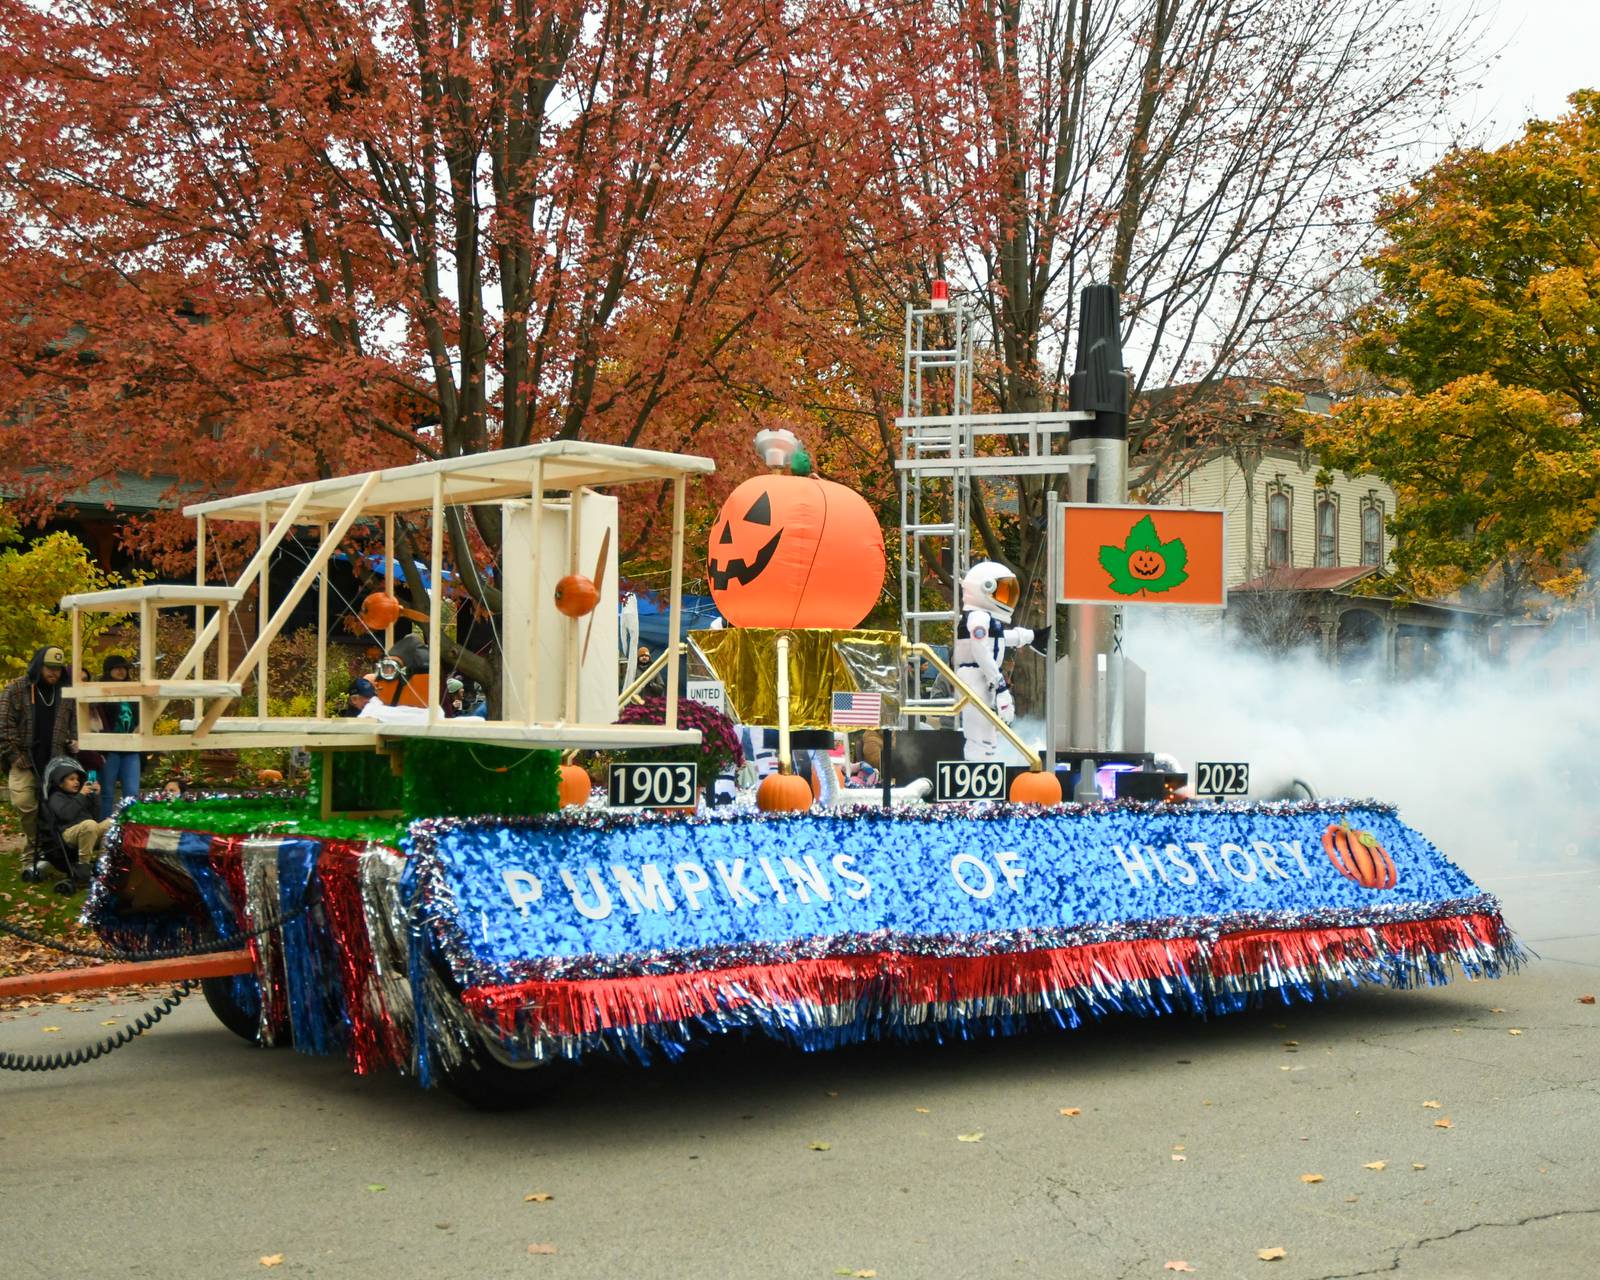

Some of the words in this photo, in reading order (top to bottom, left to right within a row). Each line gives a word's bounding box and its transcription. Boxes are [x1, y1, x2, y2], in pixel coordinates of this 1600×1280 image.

[690, 688, 720, 699] UNITED
[614, 766, 692, 804] 1903
[940, 764, 1003, 797] 1969
[1198, 764, 1248, 793] 2023
[503, 854, 872, 920] PUMPKINS
[951, 852, 1026, 899] OF
[1113, 841, 1312, 887] HISTORY
